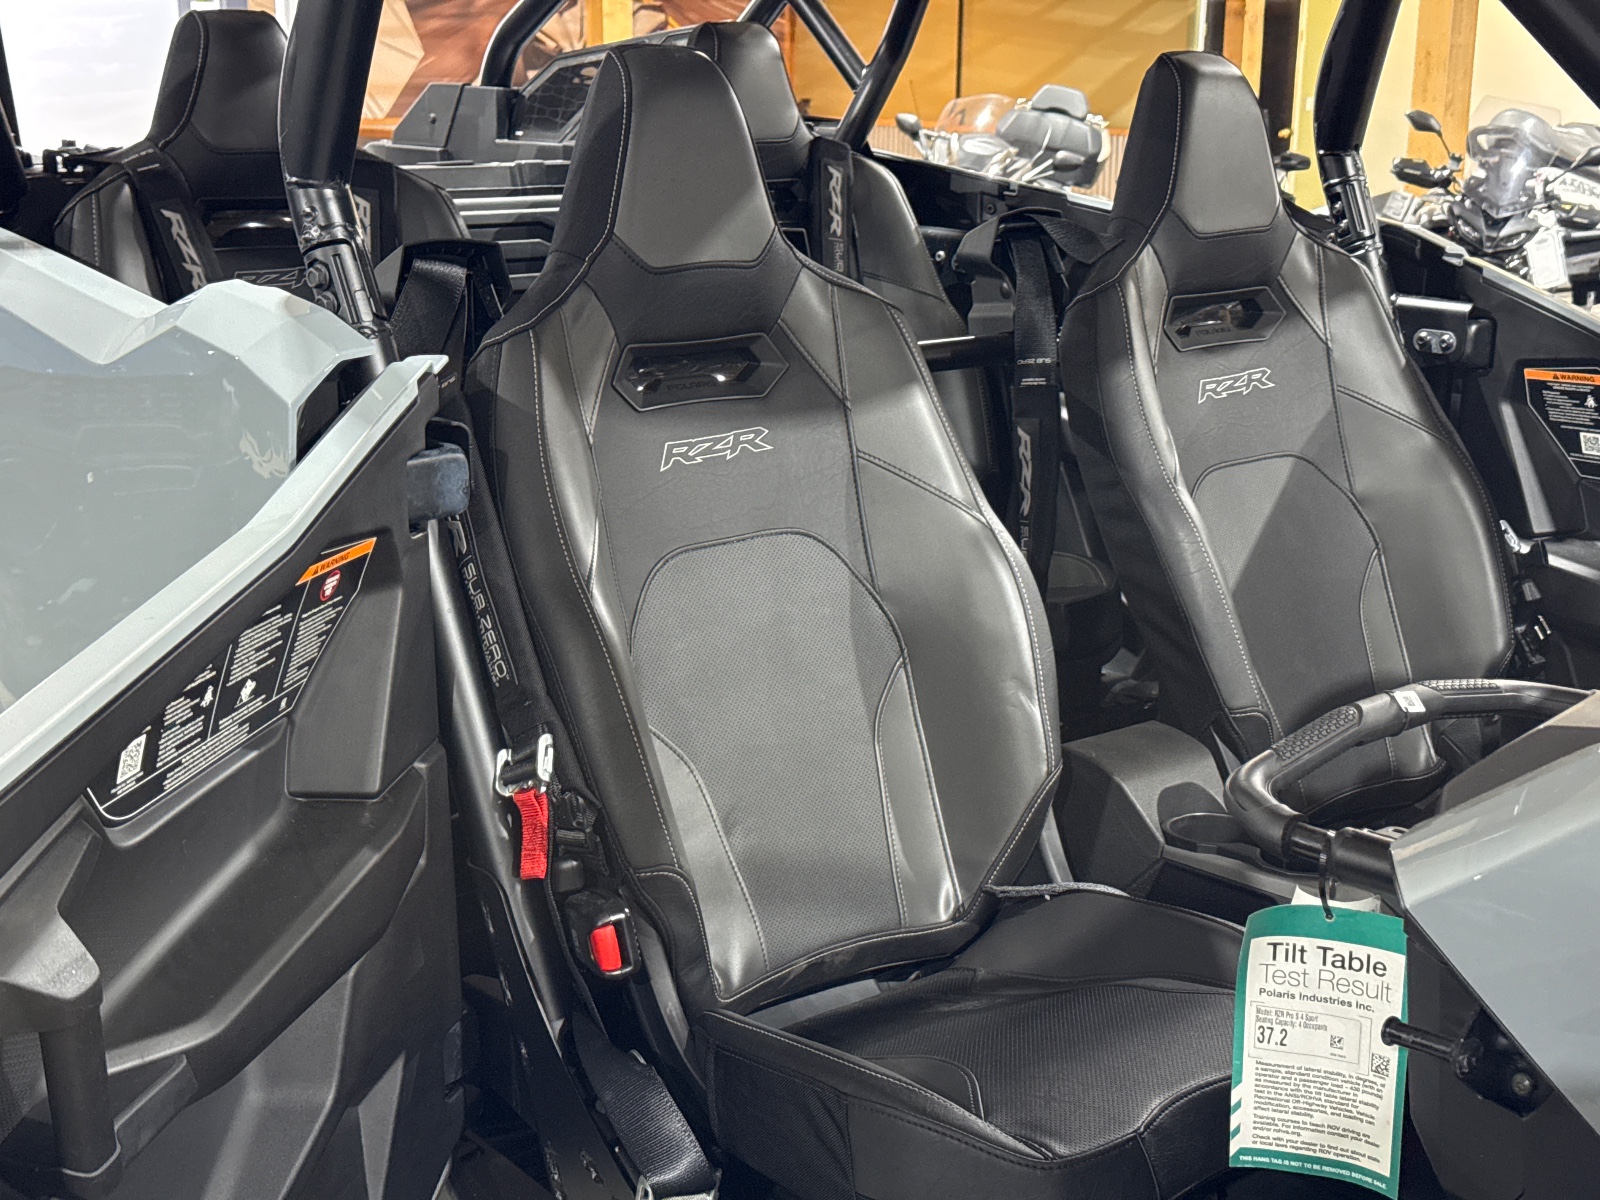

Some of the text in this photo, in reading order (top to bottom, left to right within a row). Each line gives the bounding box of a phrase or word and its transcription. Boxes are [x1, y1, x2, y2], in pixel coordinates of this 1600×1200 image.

[827, 165, 843, 237] RZR
[1198, 367, 1276, 405] RZR
[1560, 374, 1596, 383] WARNING
[660, 426, 774, 472] RZR
[1017, 426, 1033, 517] RZR
[319, 551, 351, 572] WARNING
[464, 562, 486, 611] SUB
[1267, 942, 1387, 977] Tilt Table
[1259, 963, 1392, 1003] Test Result
[1256, 1007, 1273, 1016] Model:
[1274, 1009, 1285, 1019] RZR
[1286, 1011, 1294, 1020] Pro
[1259, 987, 1375, 1013] Polaris Industries Inc.
[1256, 1015, 1274, 1025] Seating
[1303, 1021, 1328, 1032] Occupants
[1257, 1025, 1288, 1047] 37.2
[1322, 1165, 1350, 1176] REMOVED
[1352, 1172, 1373, 1184] BEFORE
[1374, 1180, 1387, 1190] SALE
